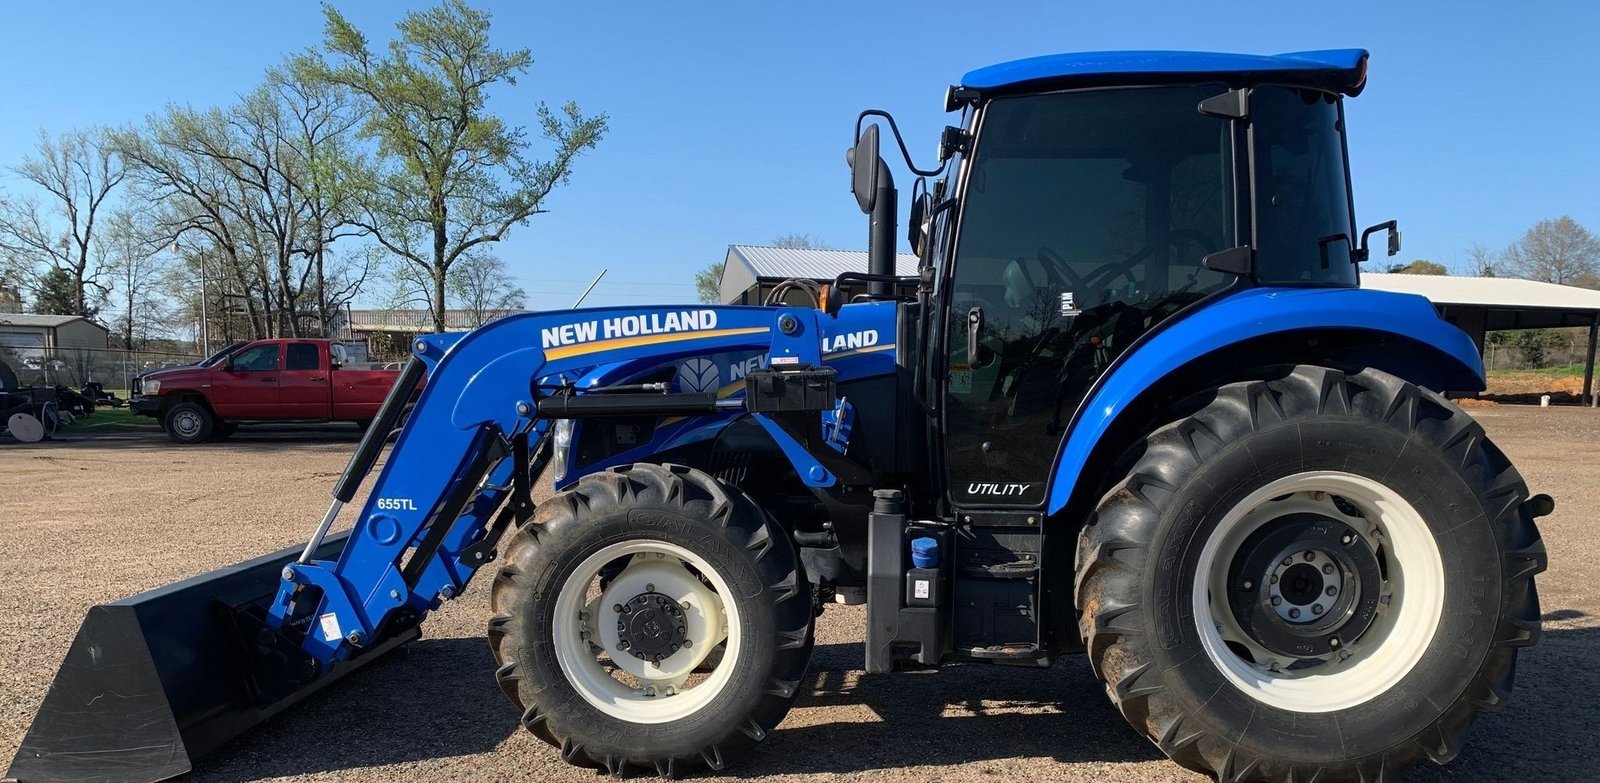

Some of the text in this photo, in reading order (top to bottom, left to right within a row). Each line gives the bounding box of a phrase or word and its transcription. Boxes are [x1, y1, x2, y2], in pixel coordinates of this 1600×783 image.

[541, 309, 718, 348] NEW HOLLAND
[377, 498, 417, 511] 655TL
[967, 482, 1030, 496] UTILITY
[636, 511, 756, 587] GALAXY
[1157, 507, 1196, 643] GALAXY
